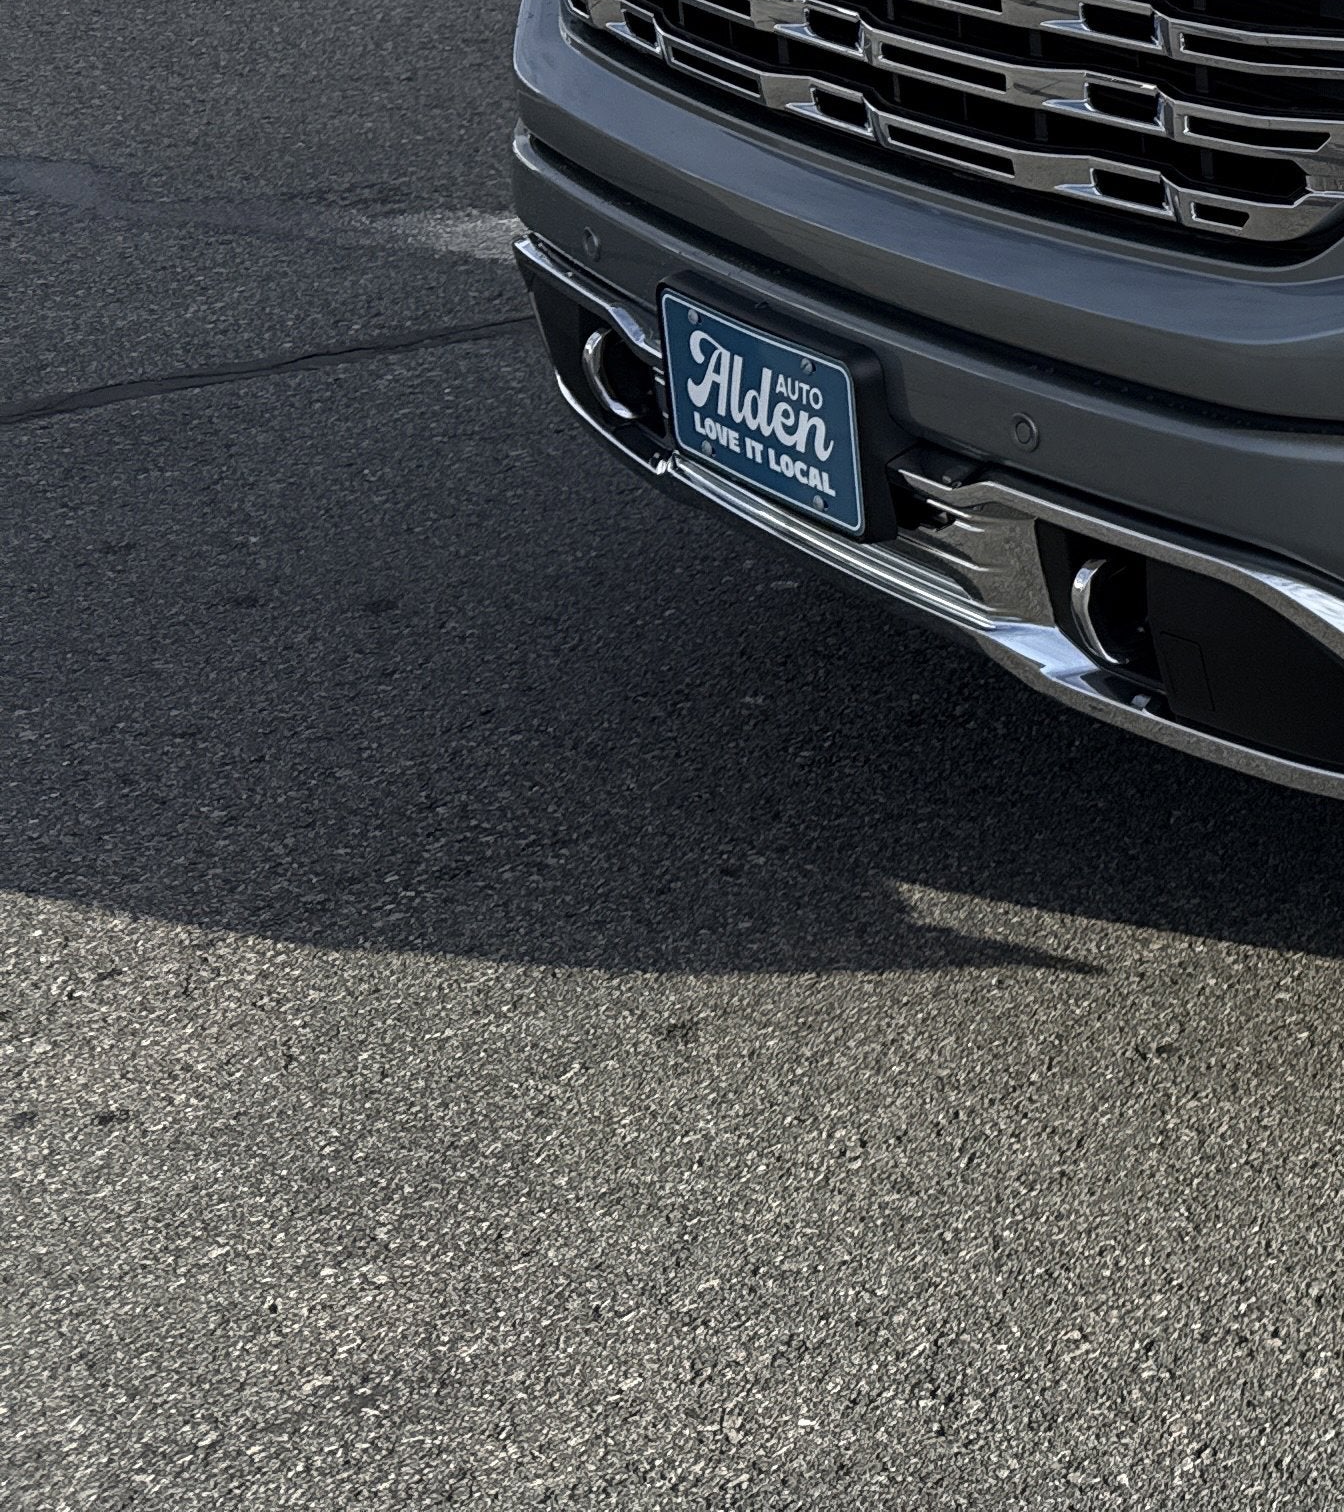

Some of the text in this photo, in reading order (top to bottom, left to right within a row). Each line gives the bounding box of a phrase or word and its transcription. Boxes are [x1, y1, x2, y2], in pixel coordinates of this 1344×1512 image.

[687, 330, 834, 462] Alden
[775, 374, 823, 410] AUTO
[694, 411, 836, 497] LOVE IT LOCAL
